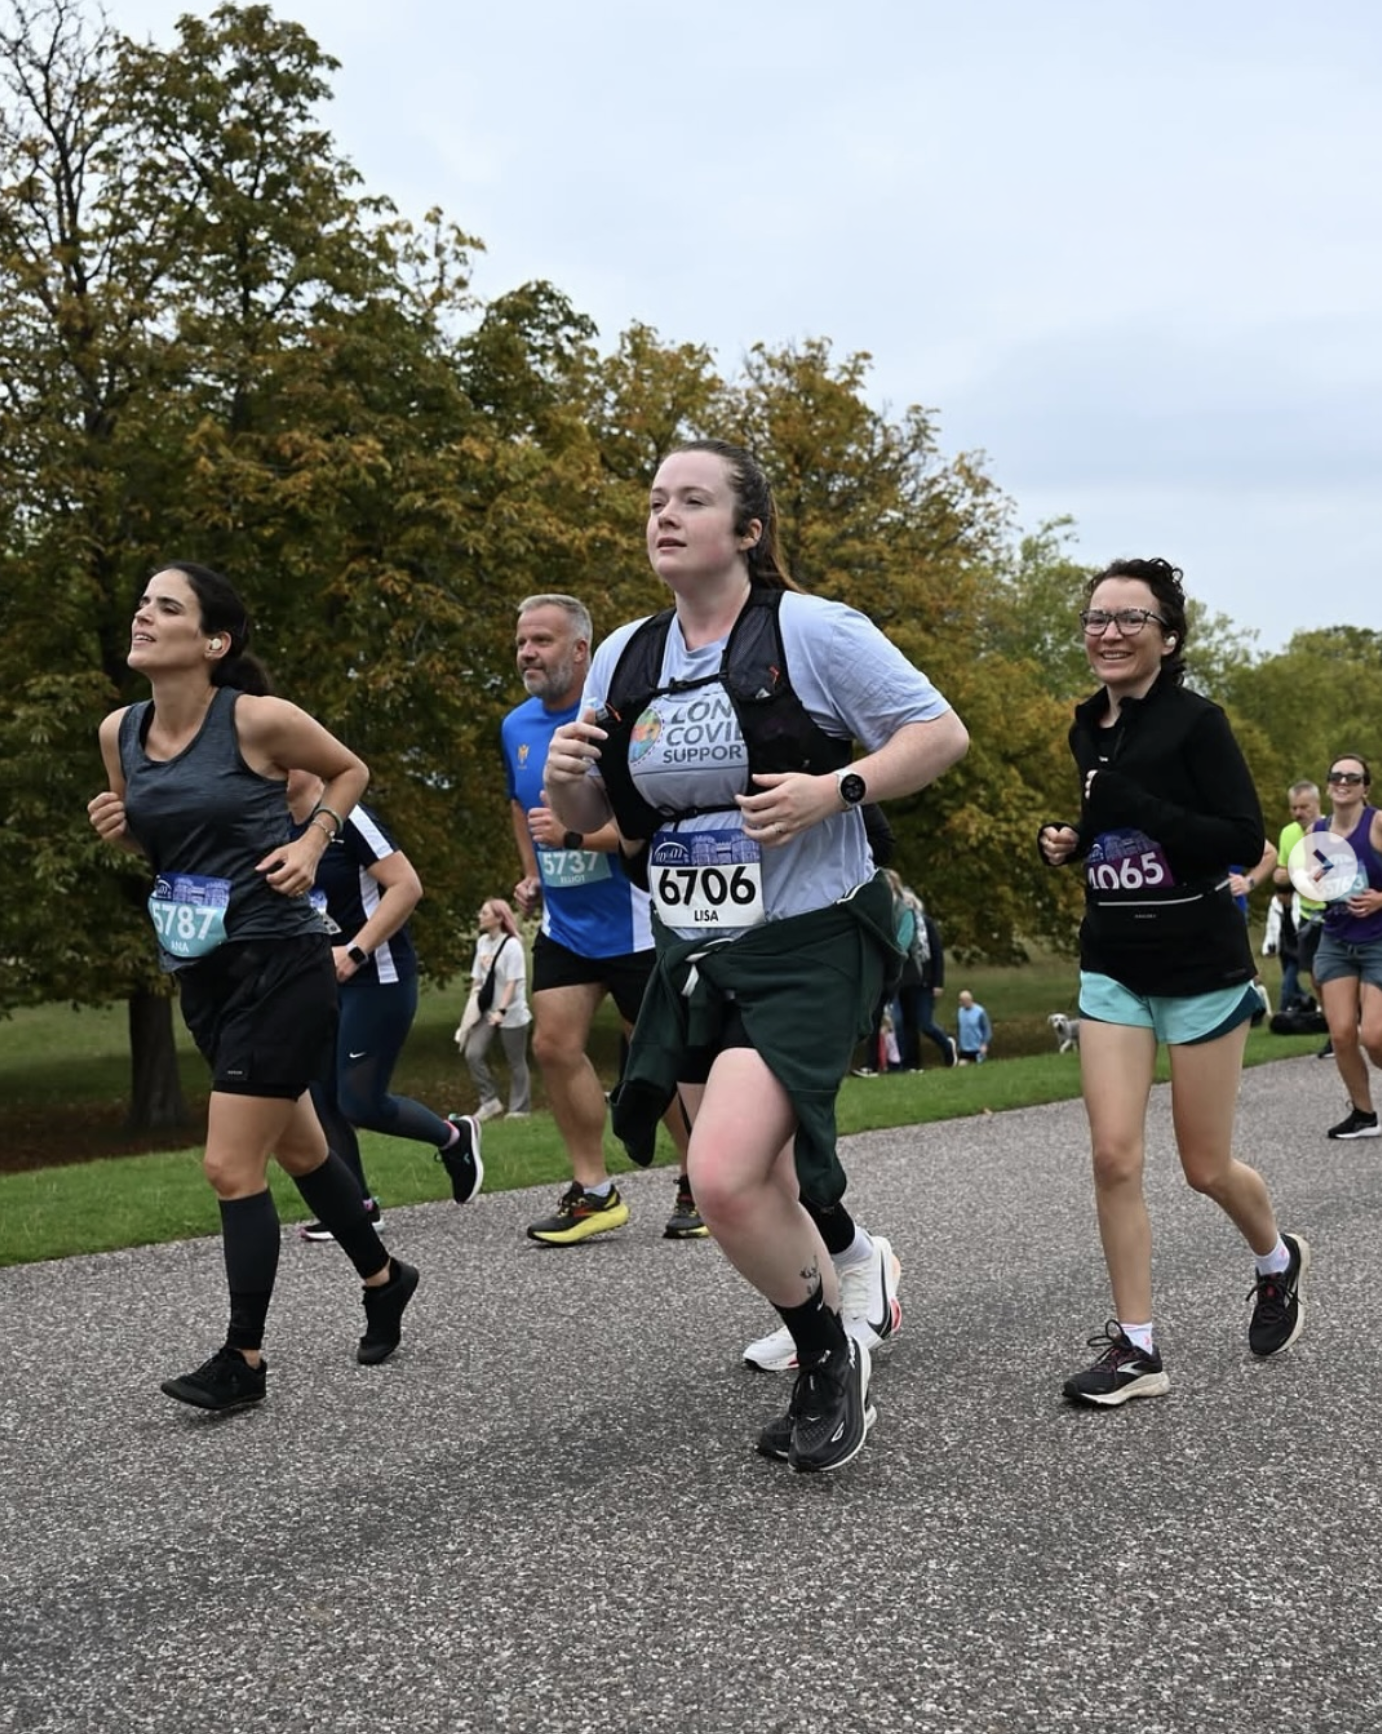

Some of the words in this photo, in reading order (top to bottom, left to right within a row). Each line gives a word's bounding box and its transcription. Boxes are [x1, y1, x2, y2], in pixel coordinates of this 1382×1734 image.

[671, 698, 732, 724] LON
[663, 744, 745, 763] SUPPOR
[542, 851, 599, 876] 5737
[658, 866, 756, 906] 6706
[152, 902, 218, 940] 5787
[694, 909, 719, 922] LISA
